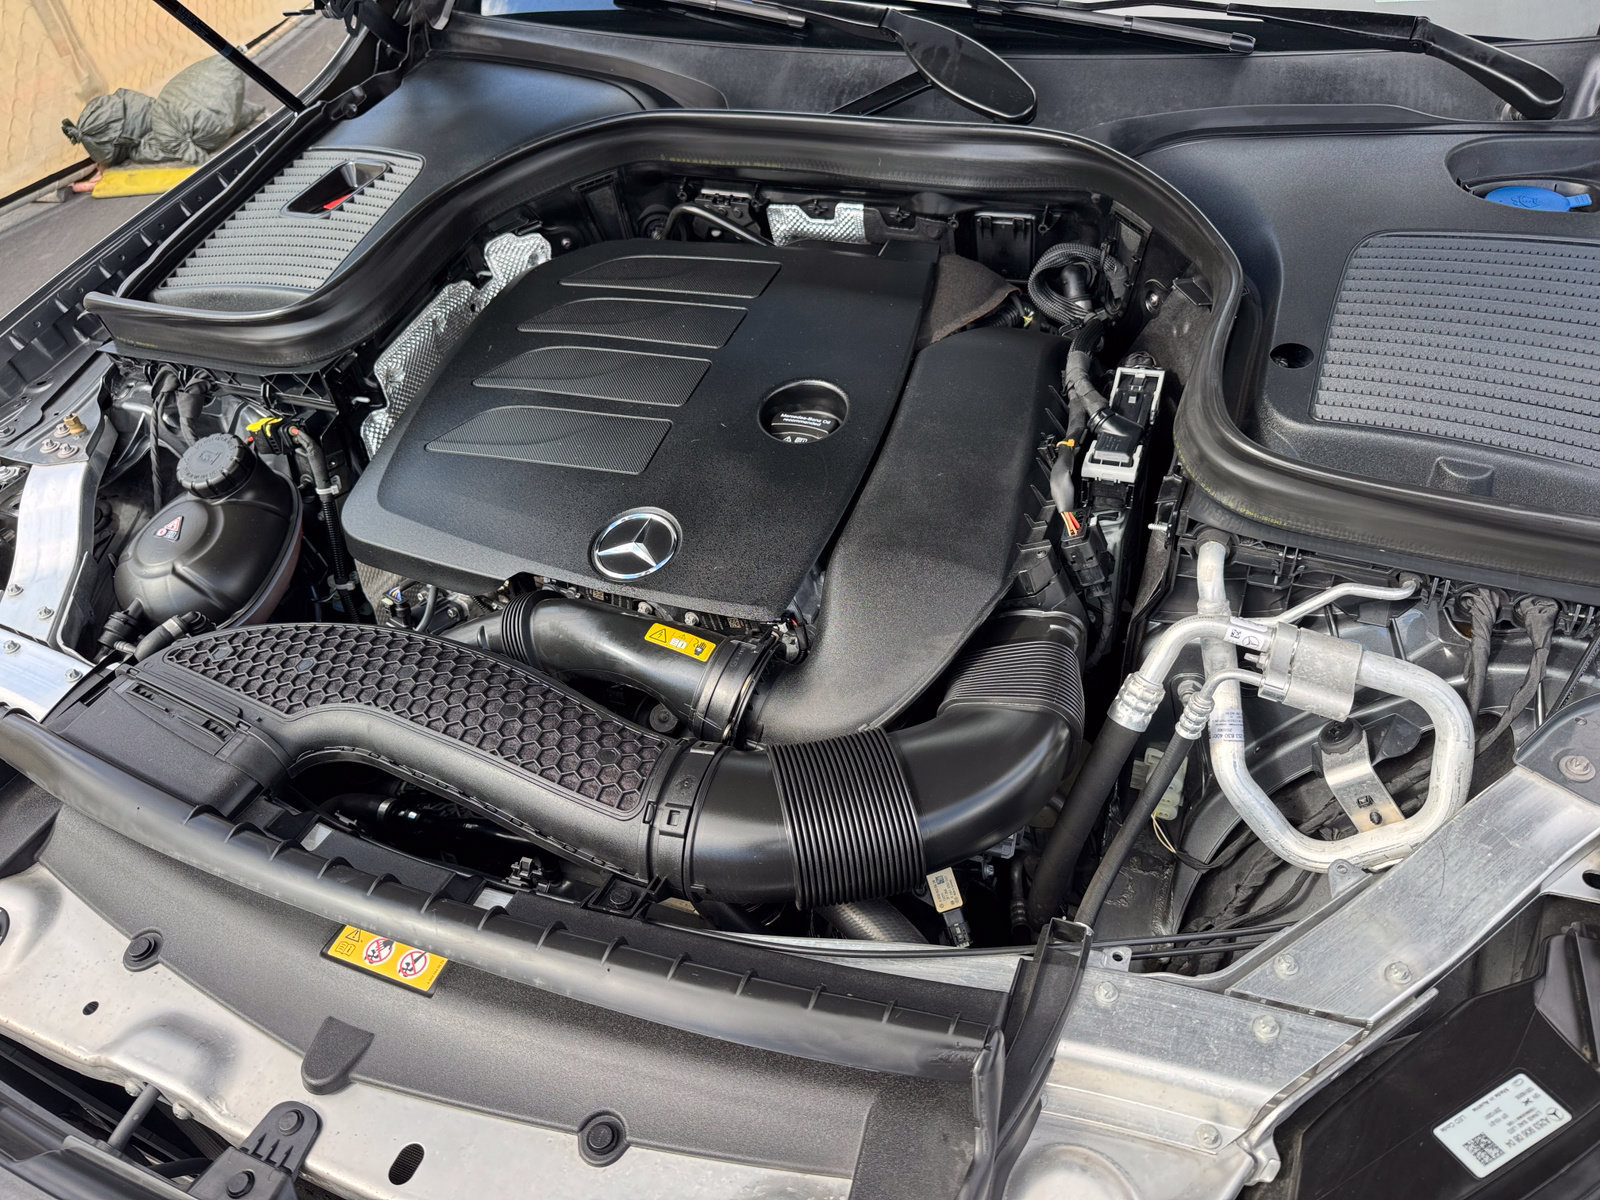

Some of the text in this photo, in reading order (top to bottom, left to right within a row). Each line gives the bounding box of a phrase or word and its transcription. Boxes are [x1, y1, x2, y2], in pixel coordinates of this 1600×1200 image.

[781, 413, 822, 422] Mercedes-Benz
[783, 418, 821, 426] recommended
[1494, 1087, 1509, 1098] Made
[1454, 1114, 1465, 1124] LED
